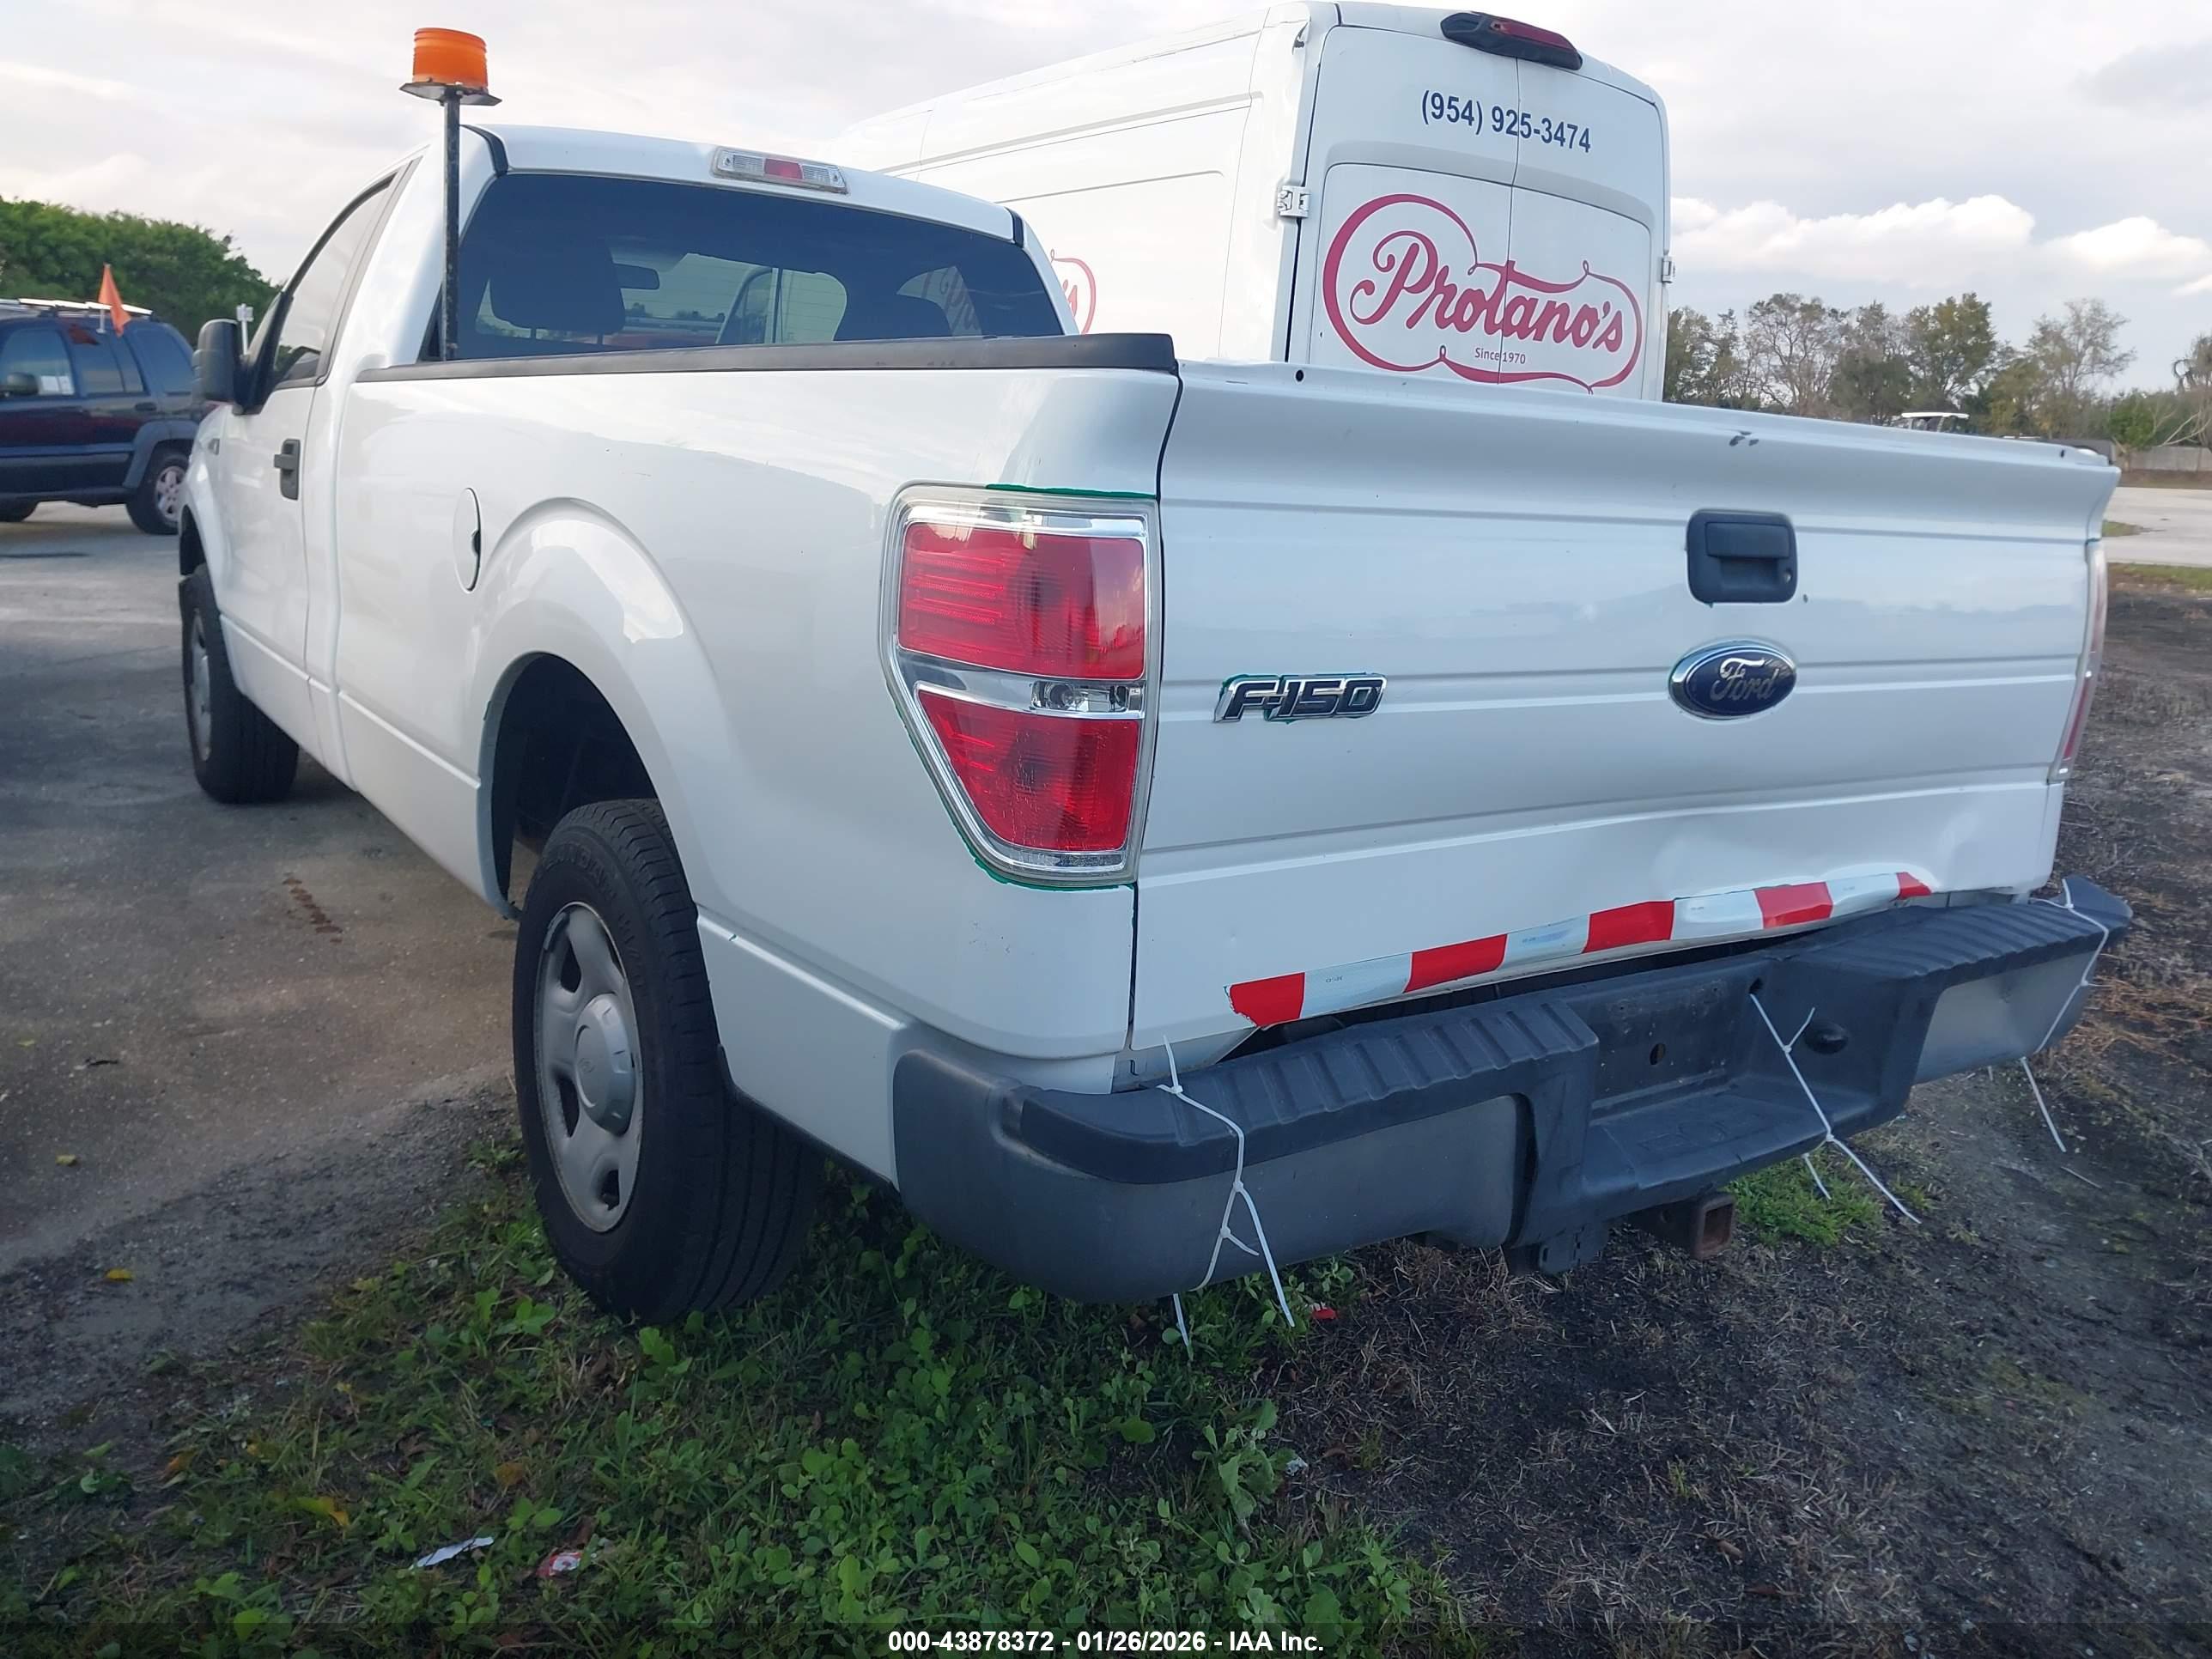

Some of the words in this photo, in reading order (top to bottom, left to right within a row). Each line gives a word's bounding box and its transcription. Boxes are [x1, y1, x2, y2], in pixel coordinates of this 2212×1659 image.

[1421, 89, 1483, 135] (954)
[1491, 105, 1591, 153] 925-3474
[1349, 229, 1624, 353] Protano's
[1474, 347, 1500, 362] Since
[1502, 351, 1526, 365] 1970
[1213, 674, 1387, 723] F-150
